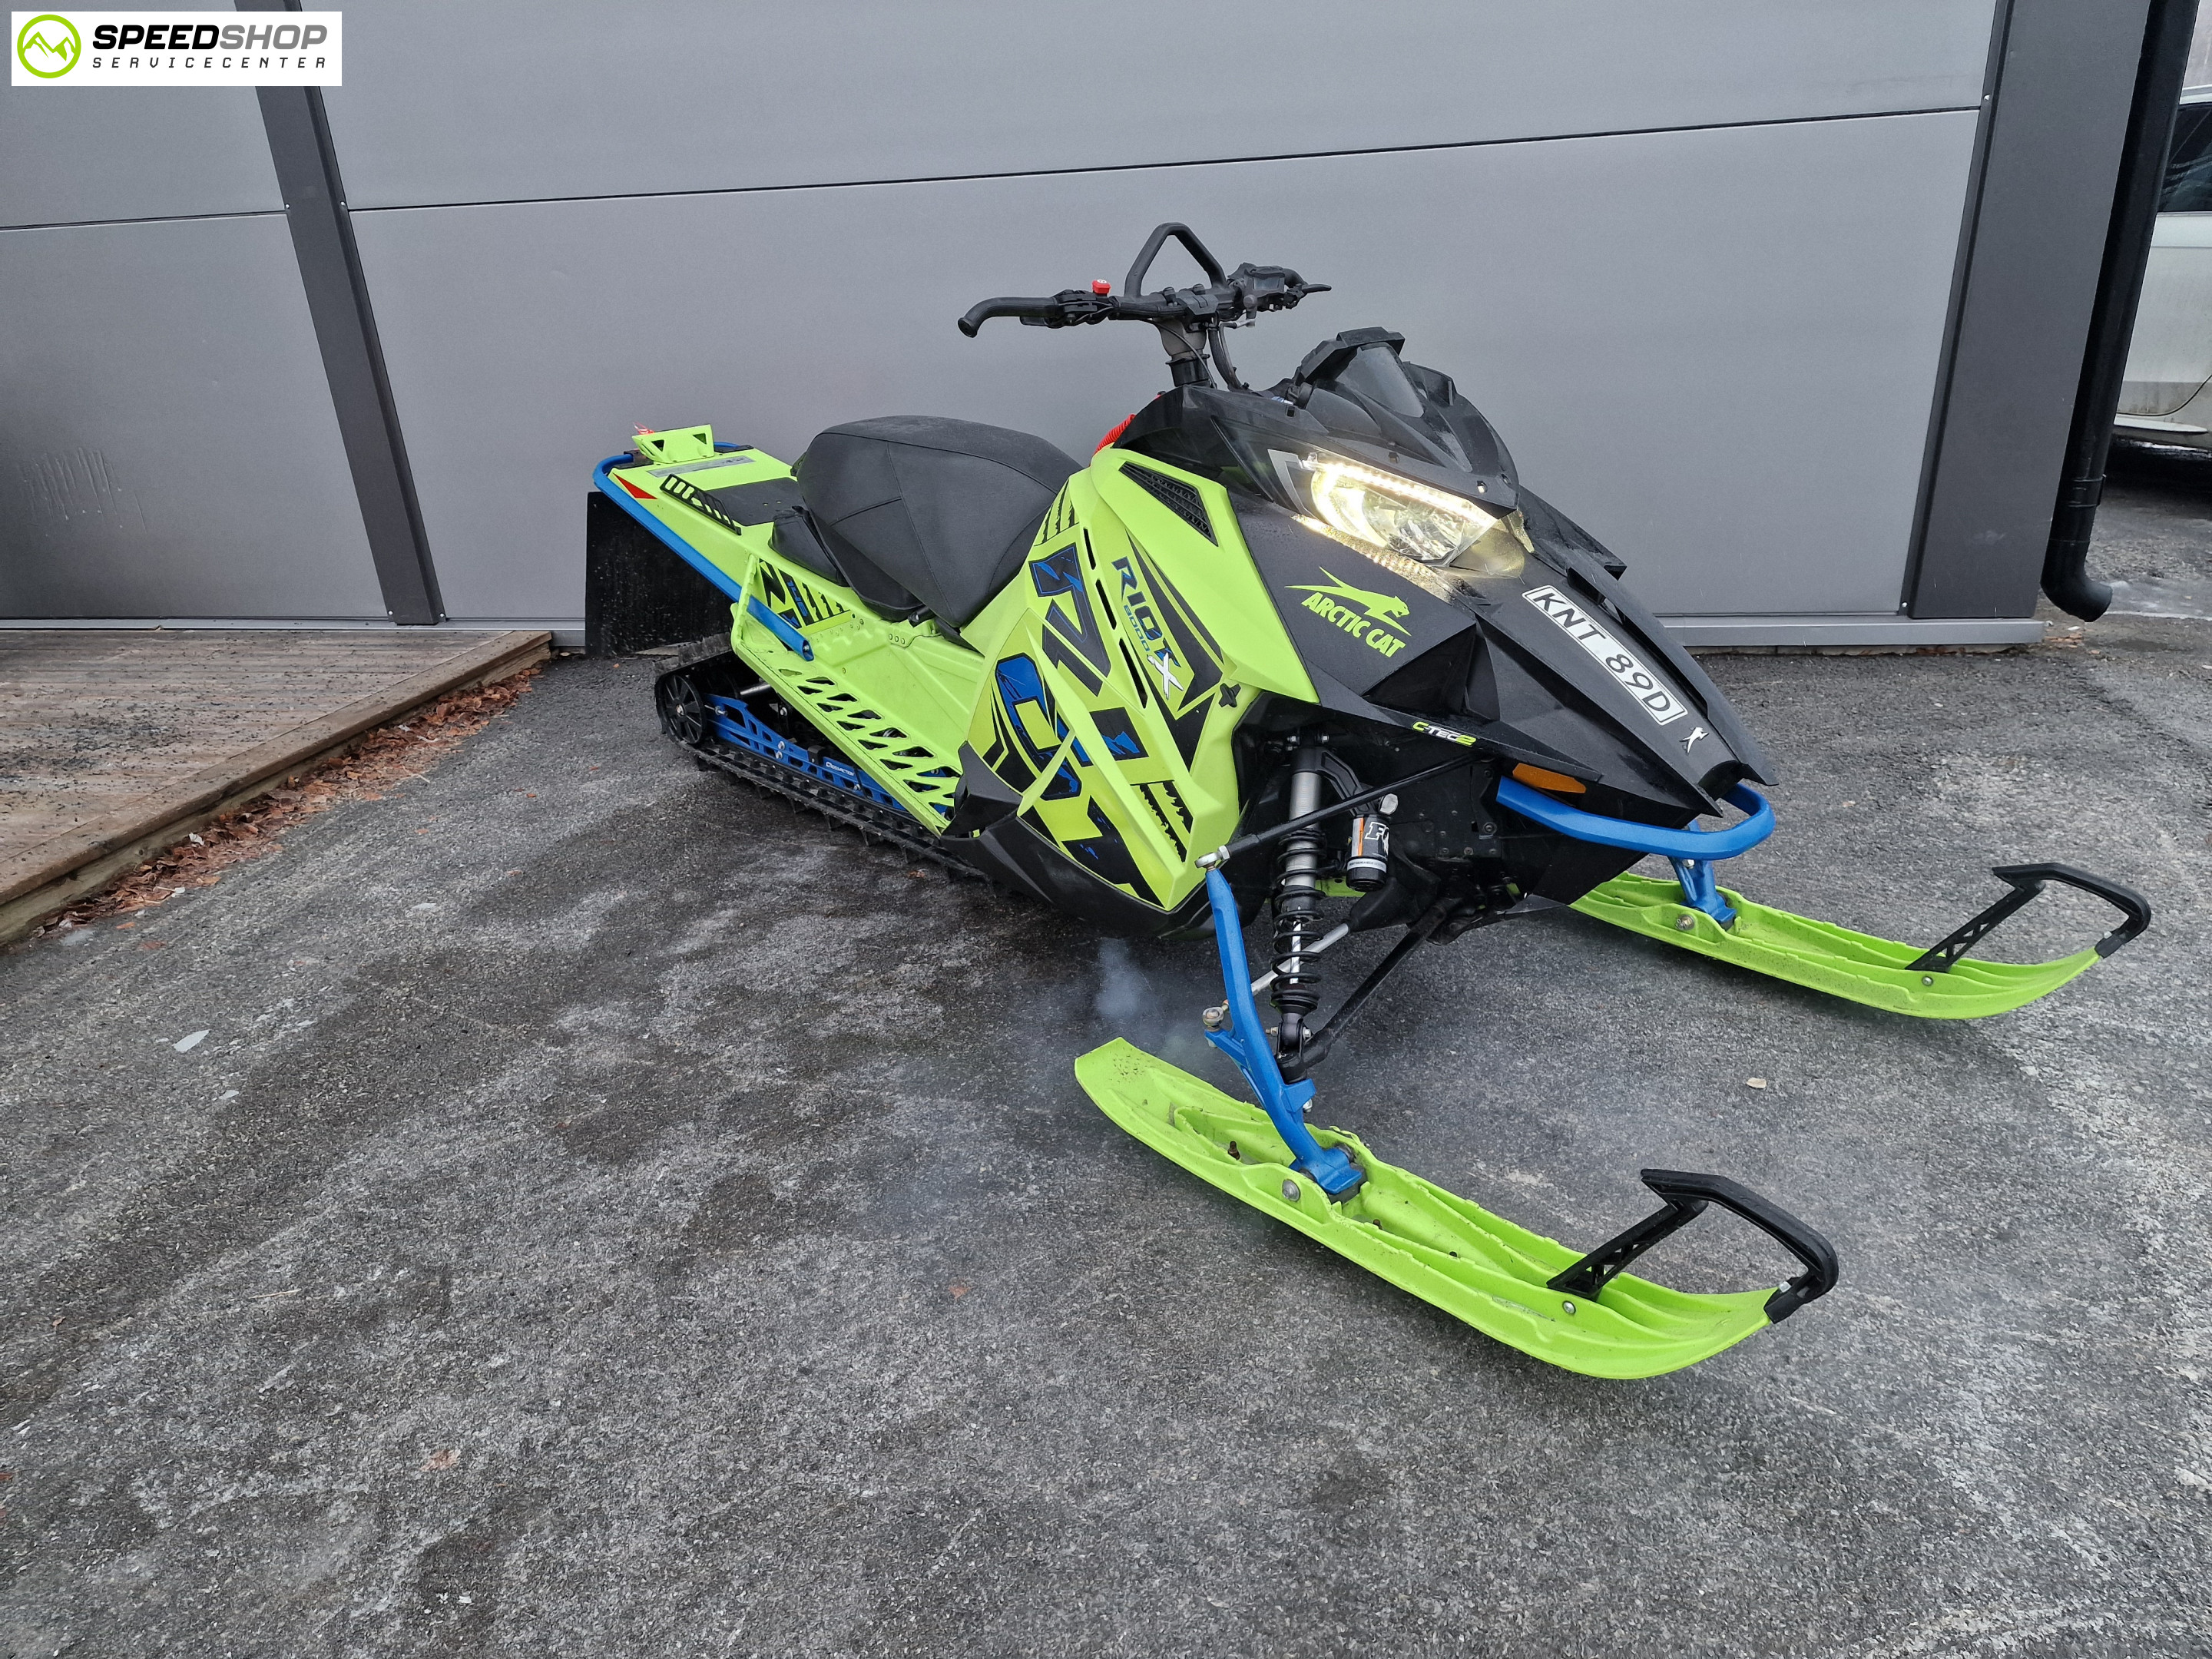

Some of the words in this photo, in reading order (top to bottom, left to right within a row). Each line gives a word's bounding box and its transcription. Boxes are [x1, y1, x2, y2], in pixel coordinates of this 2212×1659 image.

[1111, 556, 1181, 667] RIOT
[1301, 591, 1370, 639] ARCTIC
[1366, 628, 1406, 658] CAT
[1534, 592, 1607, 641] KNT
[1605, 654, 1671, 713] 89D
